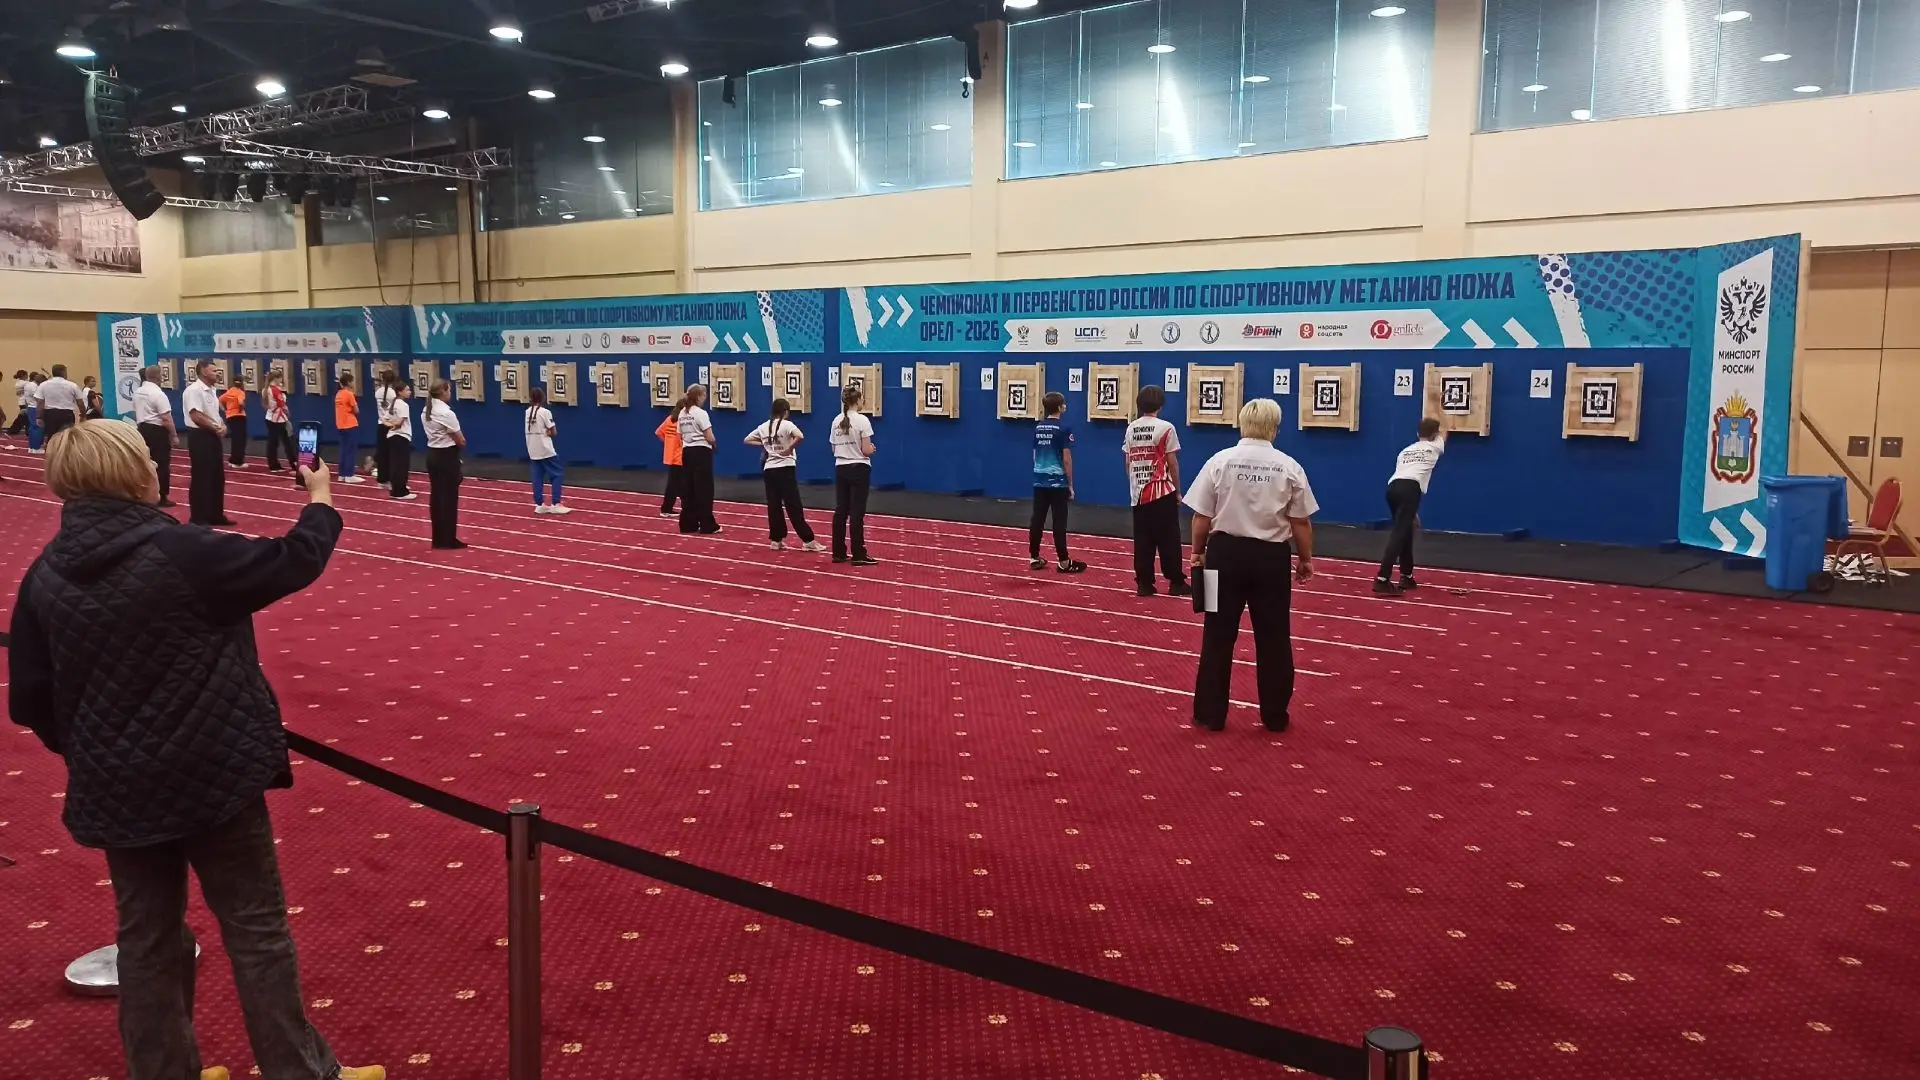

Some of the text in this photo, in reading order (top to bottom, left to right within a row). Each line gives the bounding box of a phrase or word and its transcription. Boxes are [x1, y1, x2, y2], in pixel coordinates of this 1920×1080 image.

[920, 271, 1516, 316] ЧЕМПИОНАТ И ПЕРВЕНСТВО РОССИИ ПО СПОРТИВНОМУ МЕТАНИЮ НОЖА
[666, 303, 713, 322] МЕТАНИЮ
[716, 301, 748, 320] НОЖА
[116, 328, 137, 336] 2026
[920, 321, 954, 342] ОРЕЛ
[965, 320, 1000, 341] 2026
[1718, 350, 1761, 360] МИНСПОРТ
[1722, 364, 1755, 374] РОССИИ
[700, 371, 707, 379] 15
[830, 372, 838, 380] 17
[903, 373, 912, 381] 18
[983, 373, 992, 382] 19
[1070, 374, 1081, 384] 20
[1167, 374, 1178, 384] 21
[1275, 375, 1288, 386] 22
[1396, 376, 1411, 387] 23
[1533, 377, 1549, 388] 24
[1237, 473, 1271, 483] СУДЬЯ
